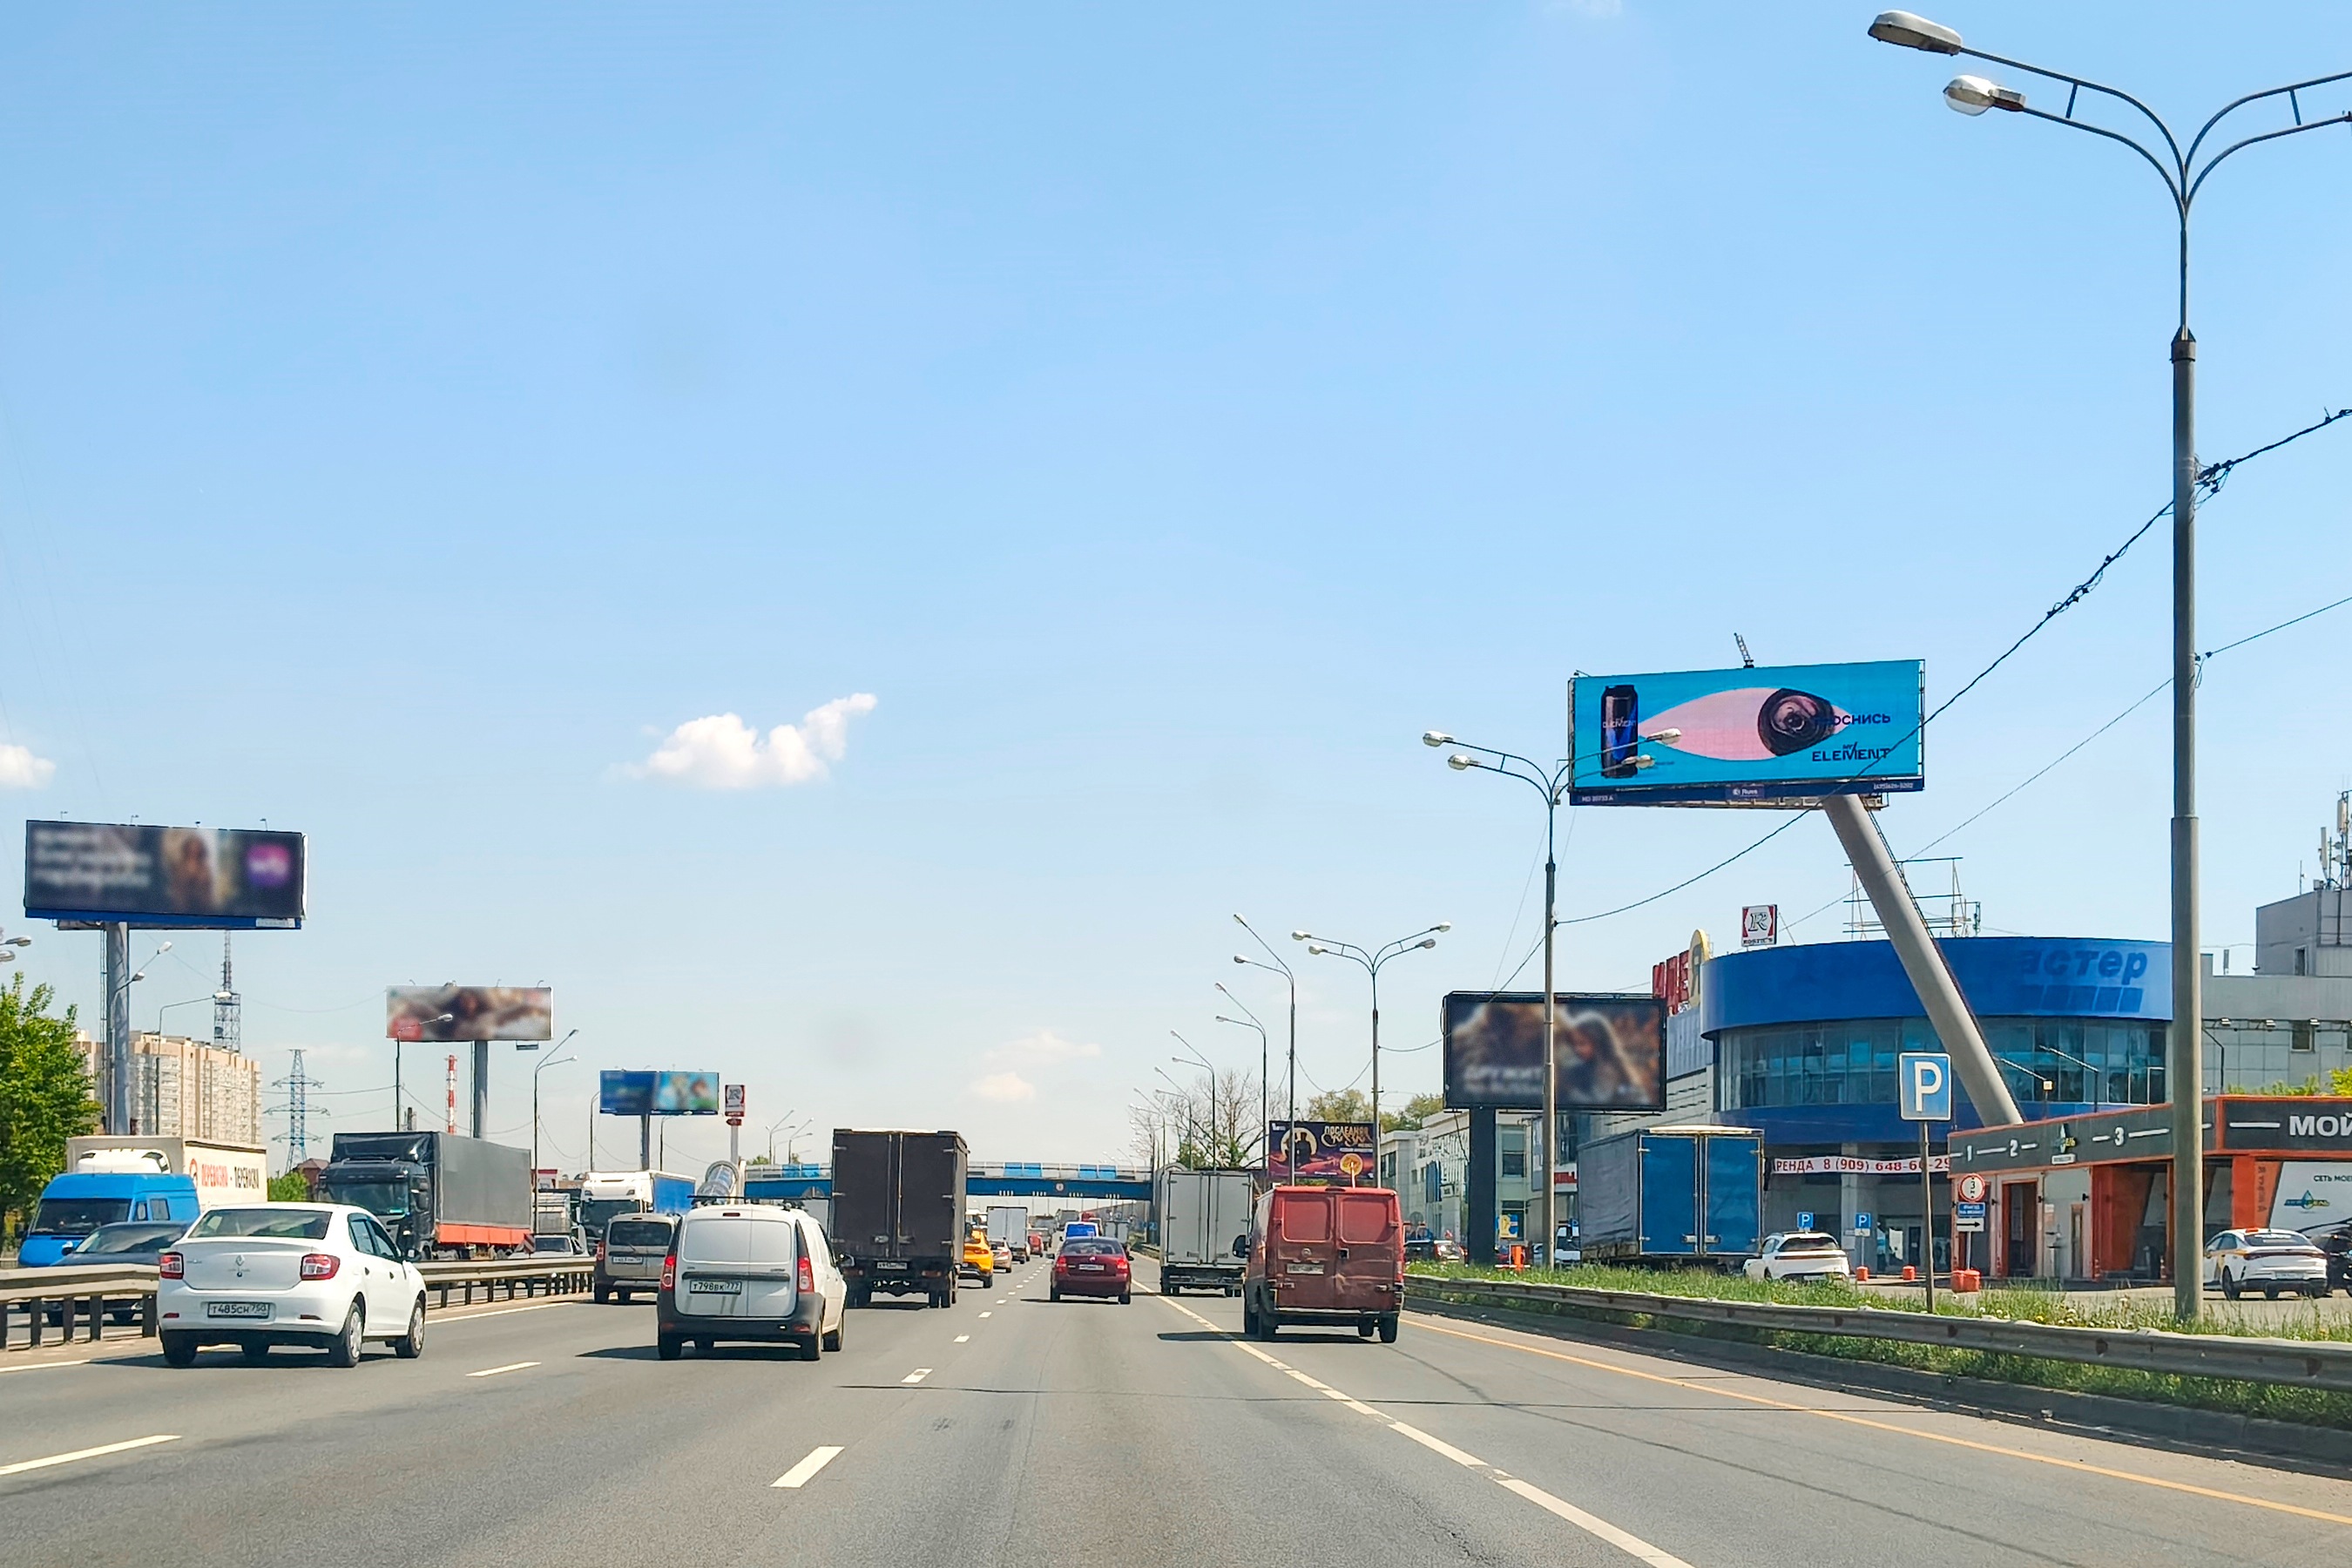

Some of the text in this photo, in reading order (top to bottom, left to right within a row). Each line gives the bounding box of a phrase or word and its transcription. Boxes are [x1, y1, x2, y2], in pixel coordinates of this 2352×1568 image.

[1812, 743, 1890, 762] ELEMENT
[1914, 1061, 1943, 1112] P
[2010, 1139, 2018, 1157] 2
[2114, 1126, 2125, 1146] 3
[1773, 1160, 1814, 1173] РЕНДА
[1823, 1159, 1830, 1170] 8
[1835, 1158, 1869, 1172] (909)
[1970, 1181, 1976, 1190] 3
[1858, 1215, 1867, 1227] P
